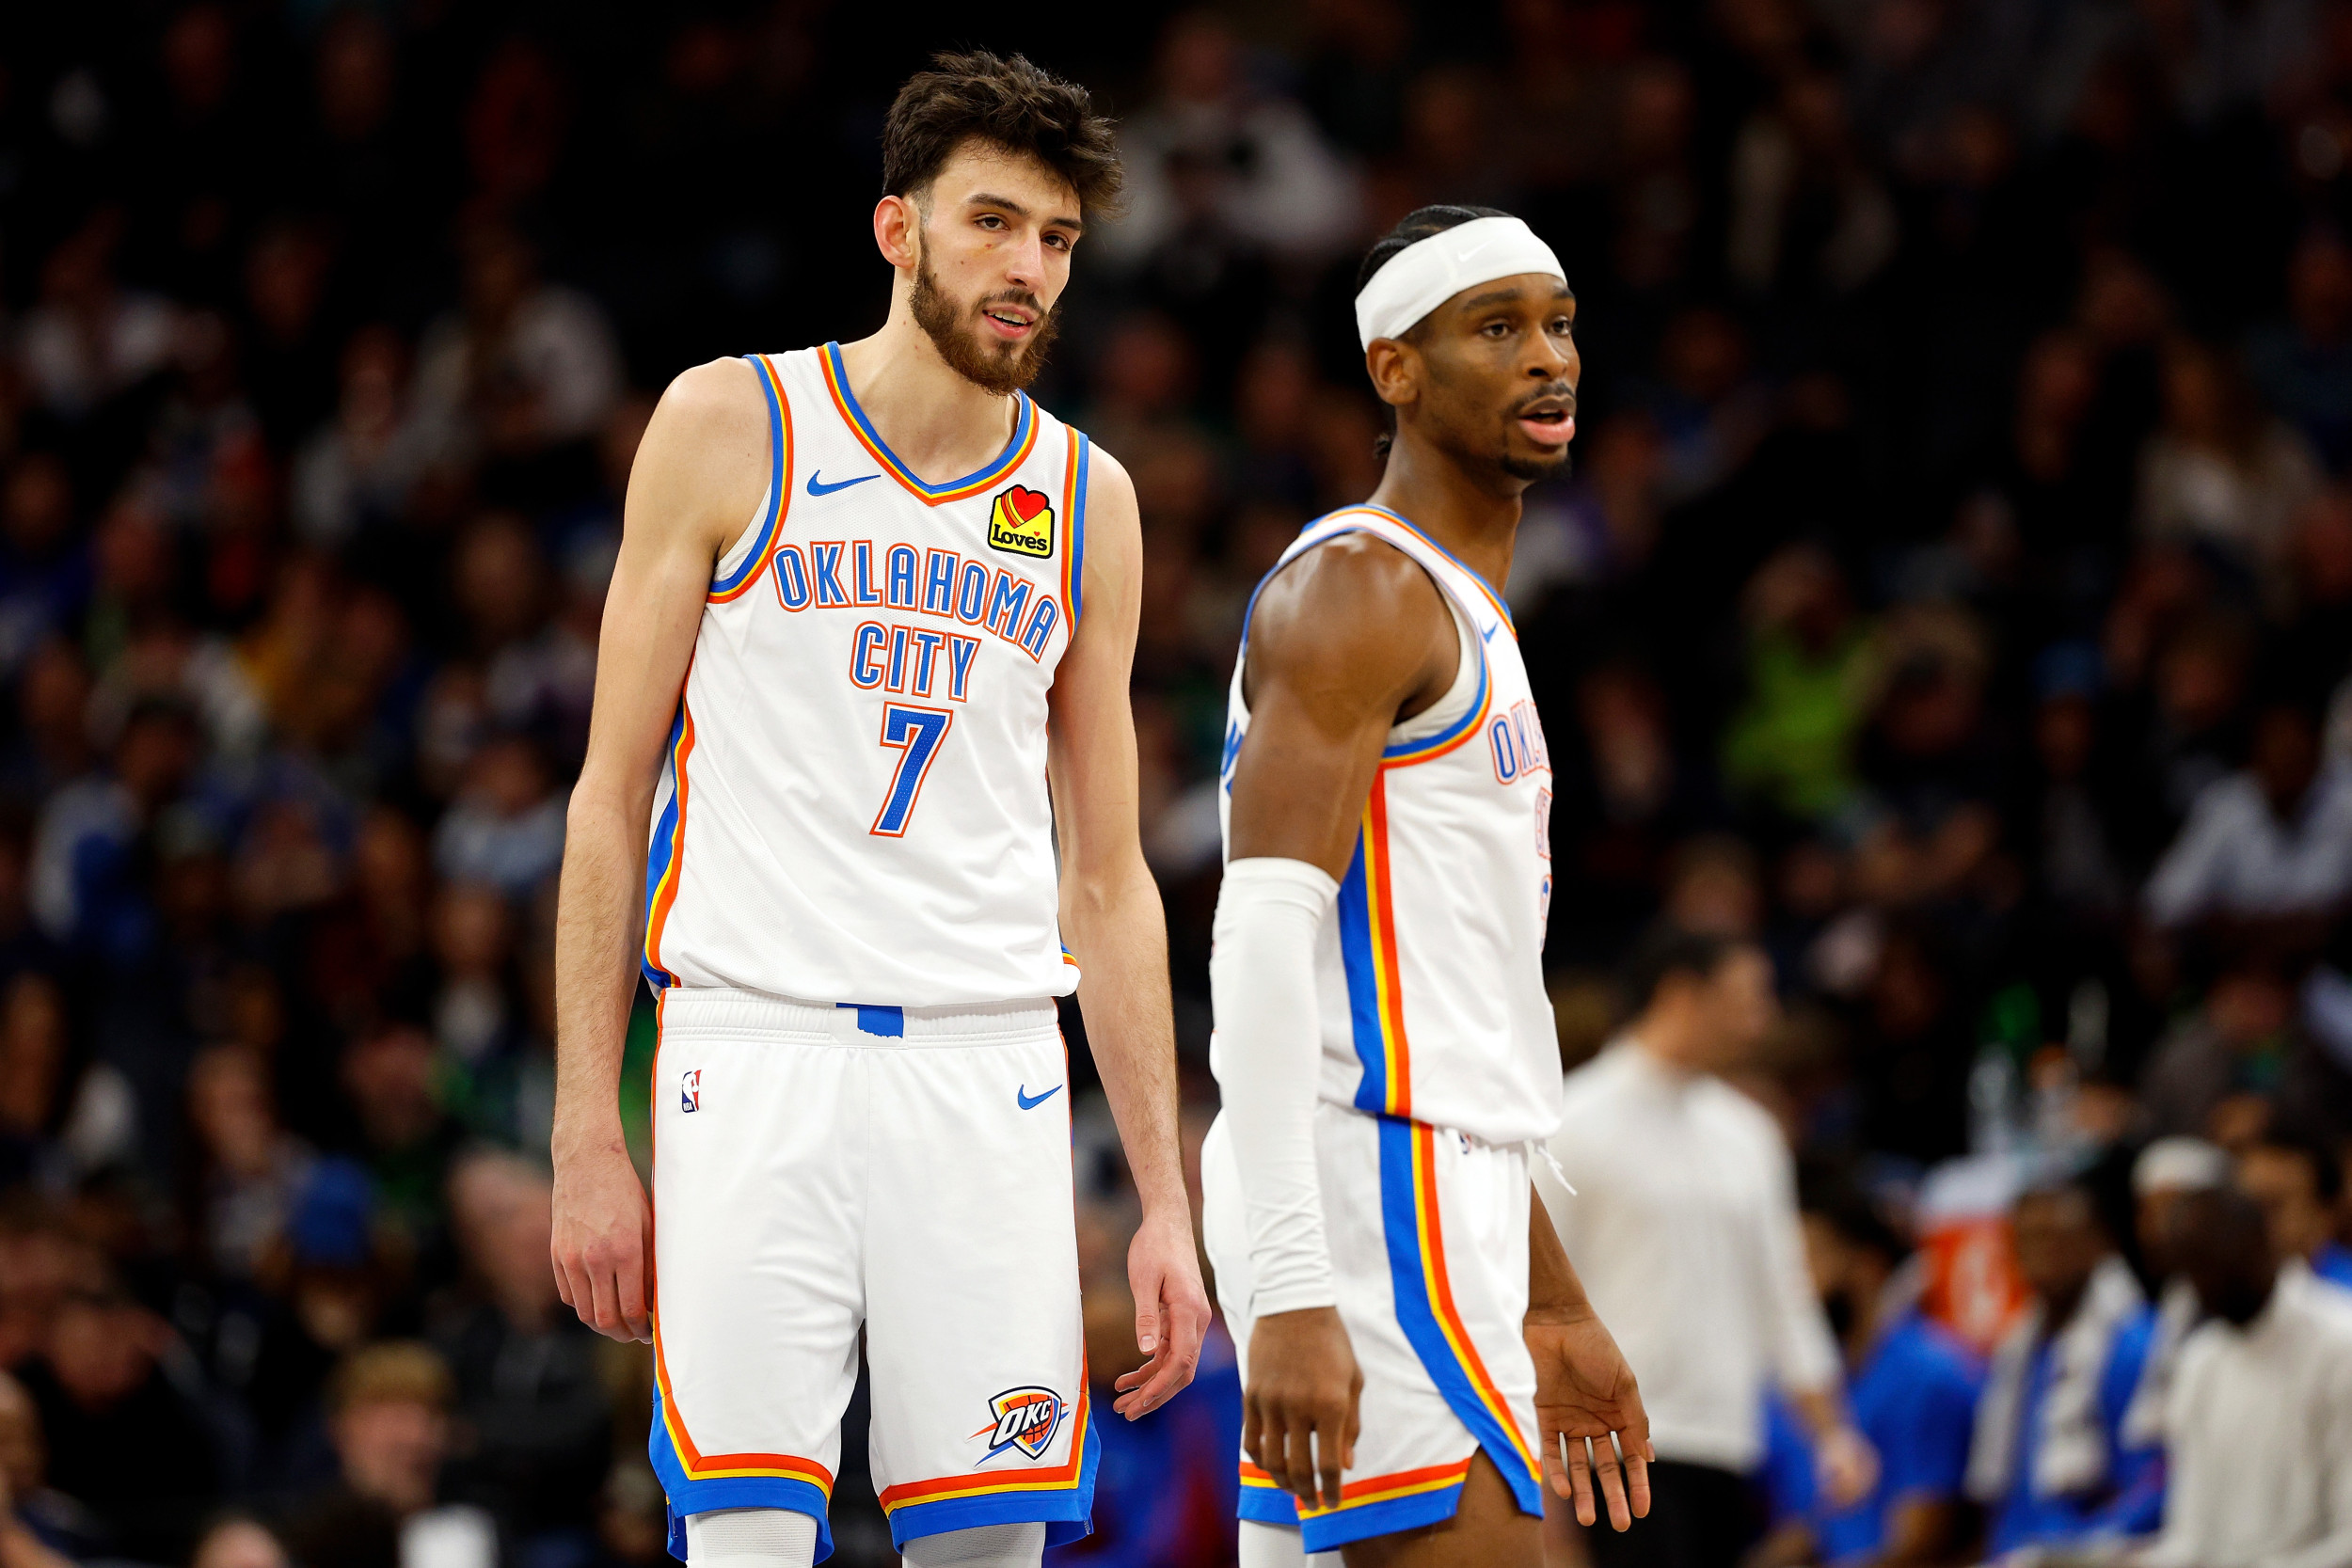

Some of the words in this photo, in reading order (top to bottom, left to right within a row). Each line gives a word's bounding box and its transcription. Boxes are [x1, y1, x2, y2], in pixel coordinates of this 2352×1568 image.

[770, 539, 1059, 664] OKLAHOMA
[850, 620, 982, 703] CITY
[868, 701, 954, 838] 7
[992, 1399, 1052, 1447] OKC
